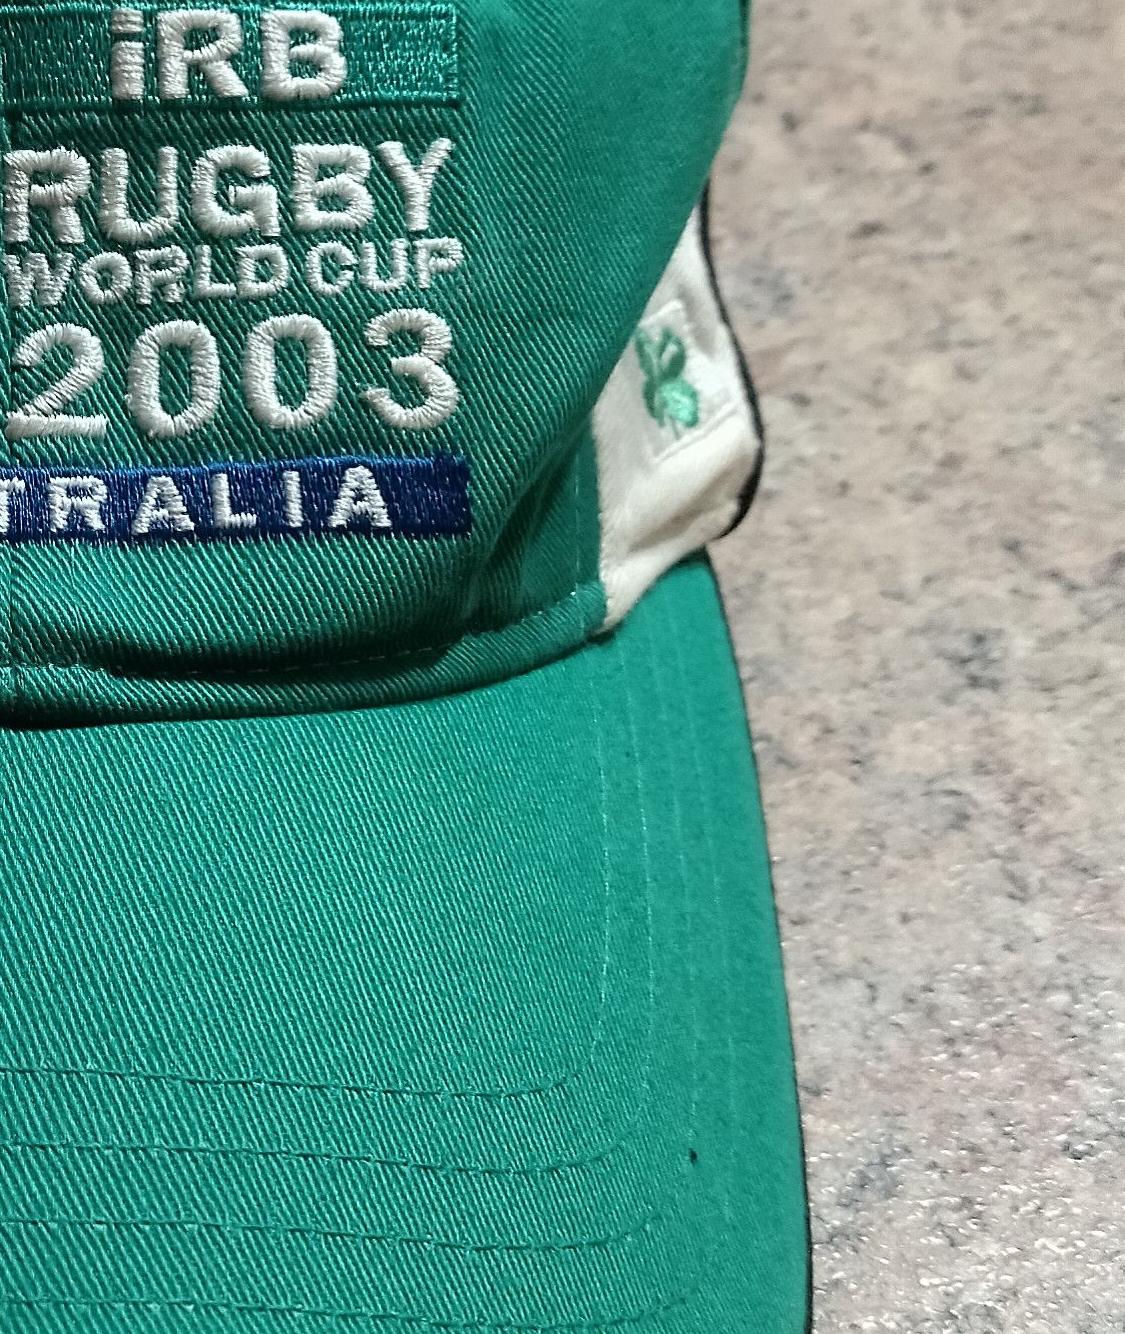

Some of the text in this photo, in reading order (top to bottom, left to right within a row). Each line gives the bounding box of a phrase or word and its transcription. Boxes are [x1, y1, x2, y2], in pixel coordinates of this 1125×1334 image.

[110, 8, 348, 101] iRB
[3, 138, 454, 243] RUGBY
[6, 237, 463, 307] WORLD CUP
[5, 308, 460, 440] 2003
